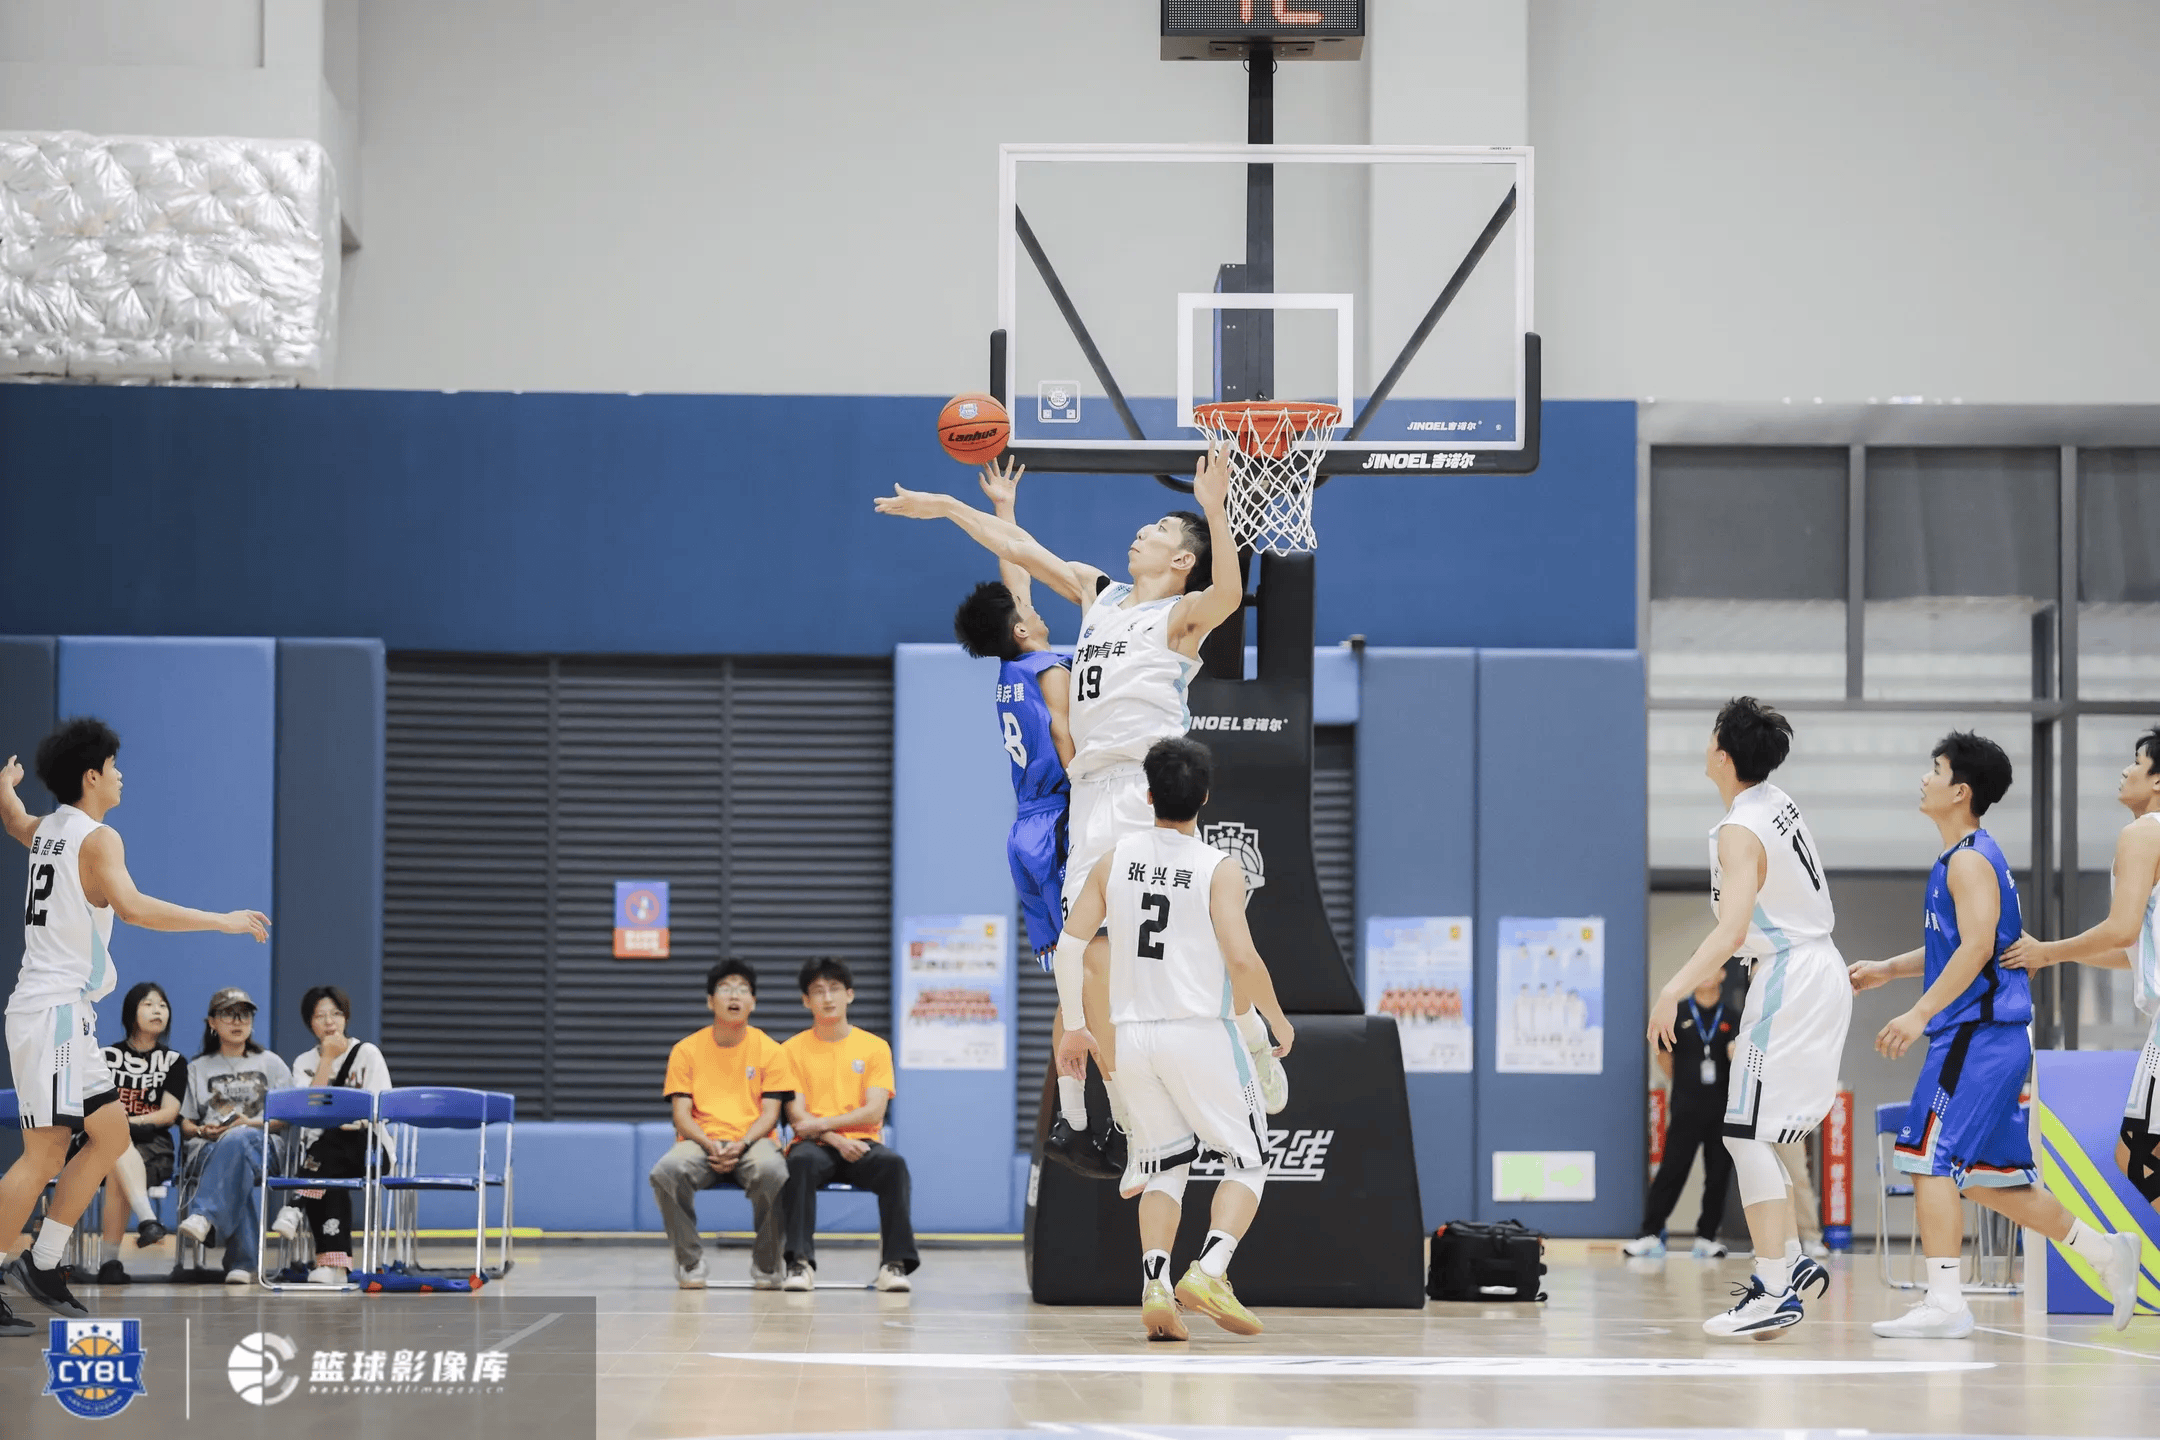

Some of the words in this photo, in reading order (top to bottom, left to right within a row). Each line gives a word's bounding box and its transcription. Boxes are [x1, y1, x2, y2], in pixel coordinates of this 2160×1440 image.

[948, 428, 997, 441] Lanhua
[1078, 665, 1103, 701] 19
[1002, 712, 1027, 769] 8
[1127, 862, 1193, 889] 张兴亮
[25, 863, 55, 927] 12
[1137, 892, 1170, 960] 2
[111, 1068, 167, 1089] ITTER
